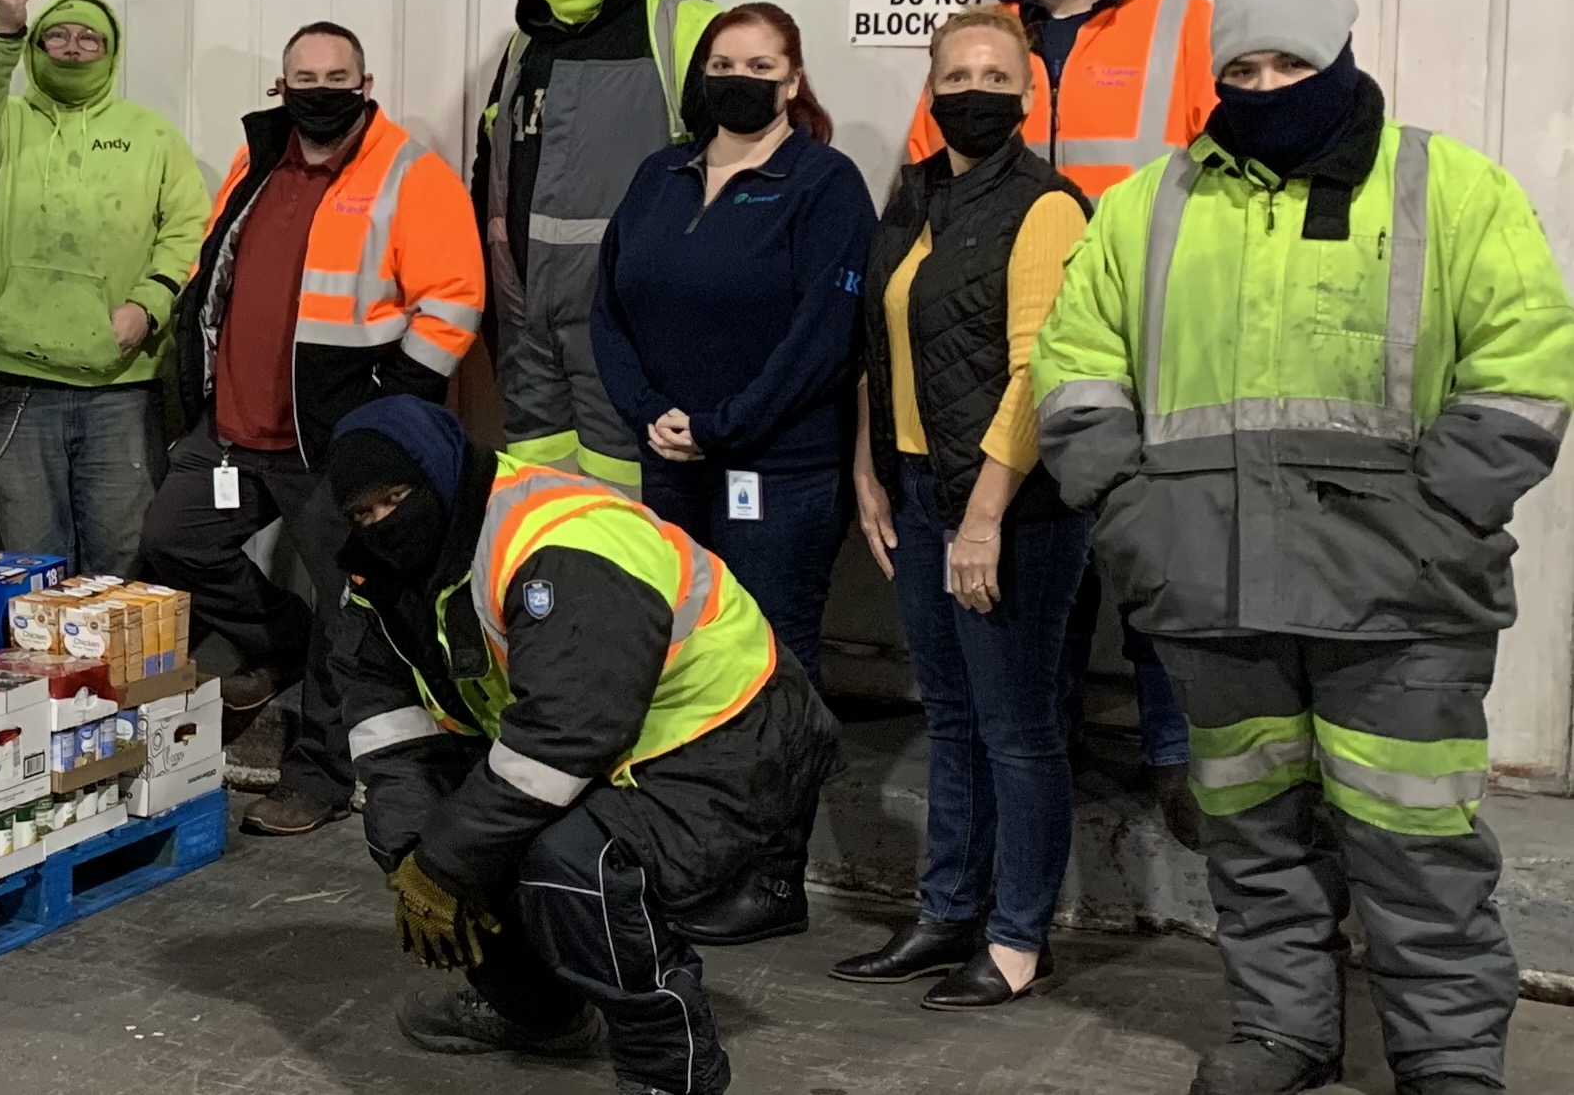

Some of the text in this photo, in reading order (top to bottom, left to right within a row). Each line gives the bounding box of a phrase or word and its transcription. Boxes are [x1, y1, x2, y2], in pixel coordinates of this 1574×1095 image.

[855, 12, 940, 35] BLOCK
[91, 138, 132, 153] Andy
[45, 567, 58, 587] 18
[73, 637, 101, 648] Chicken
